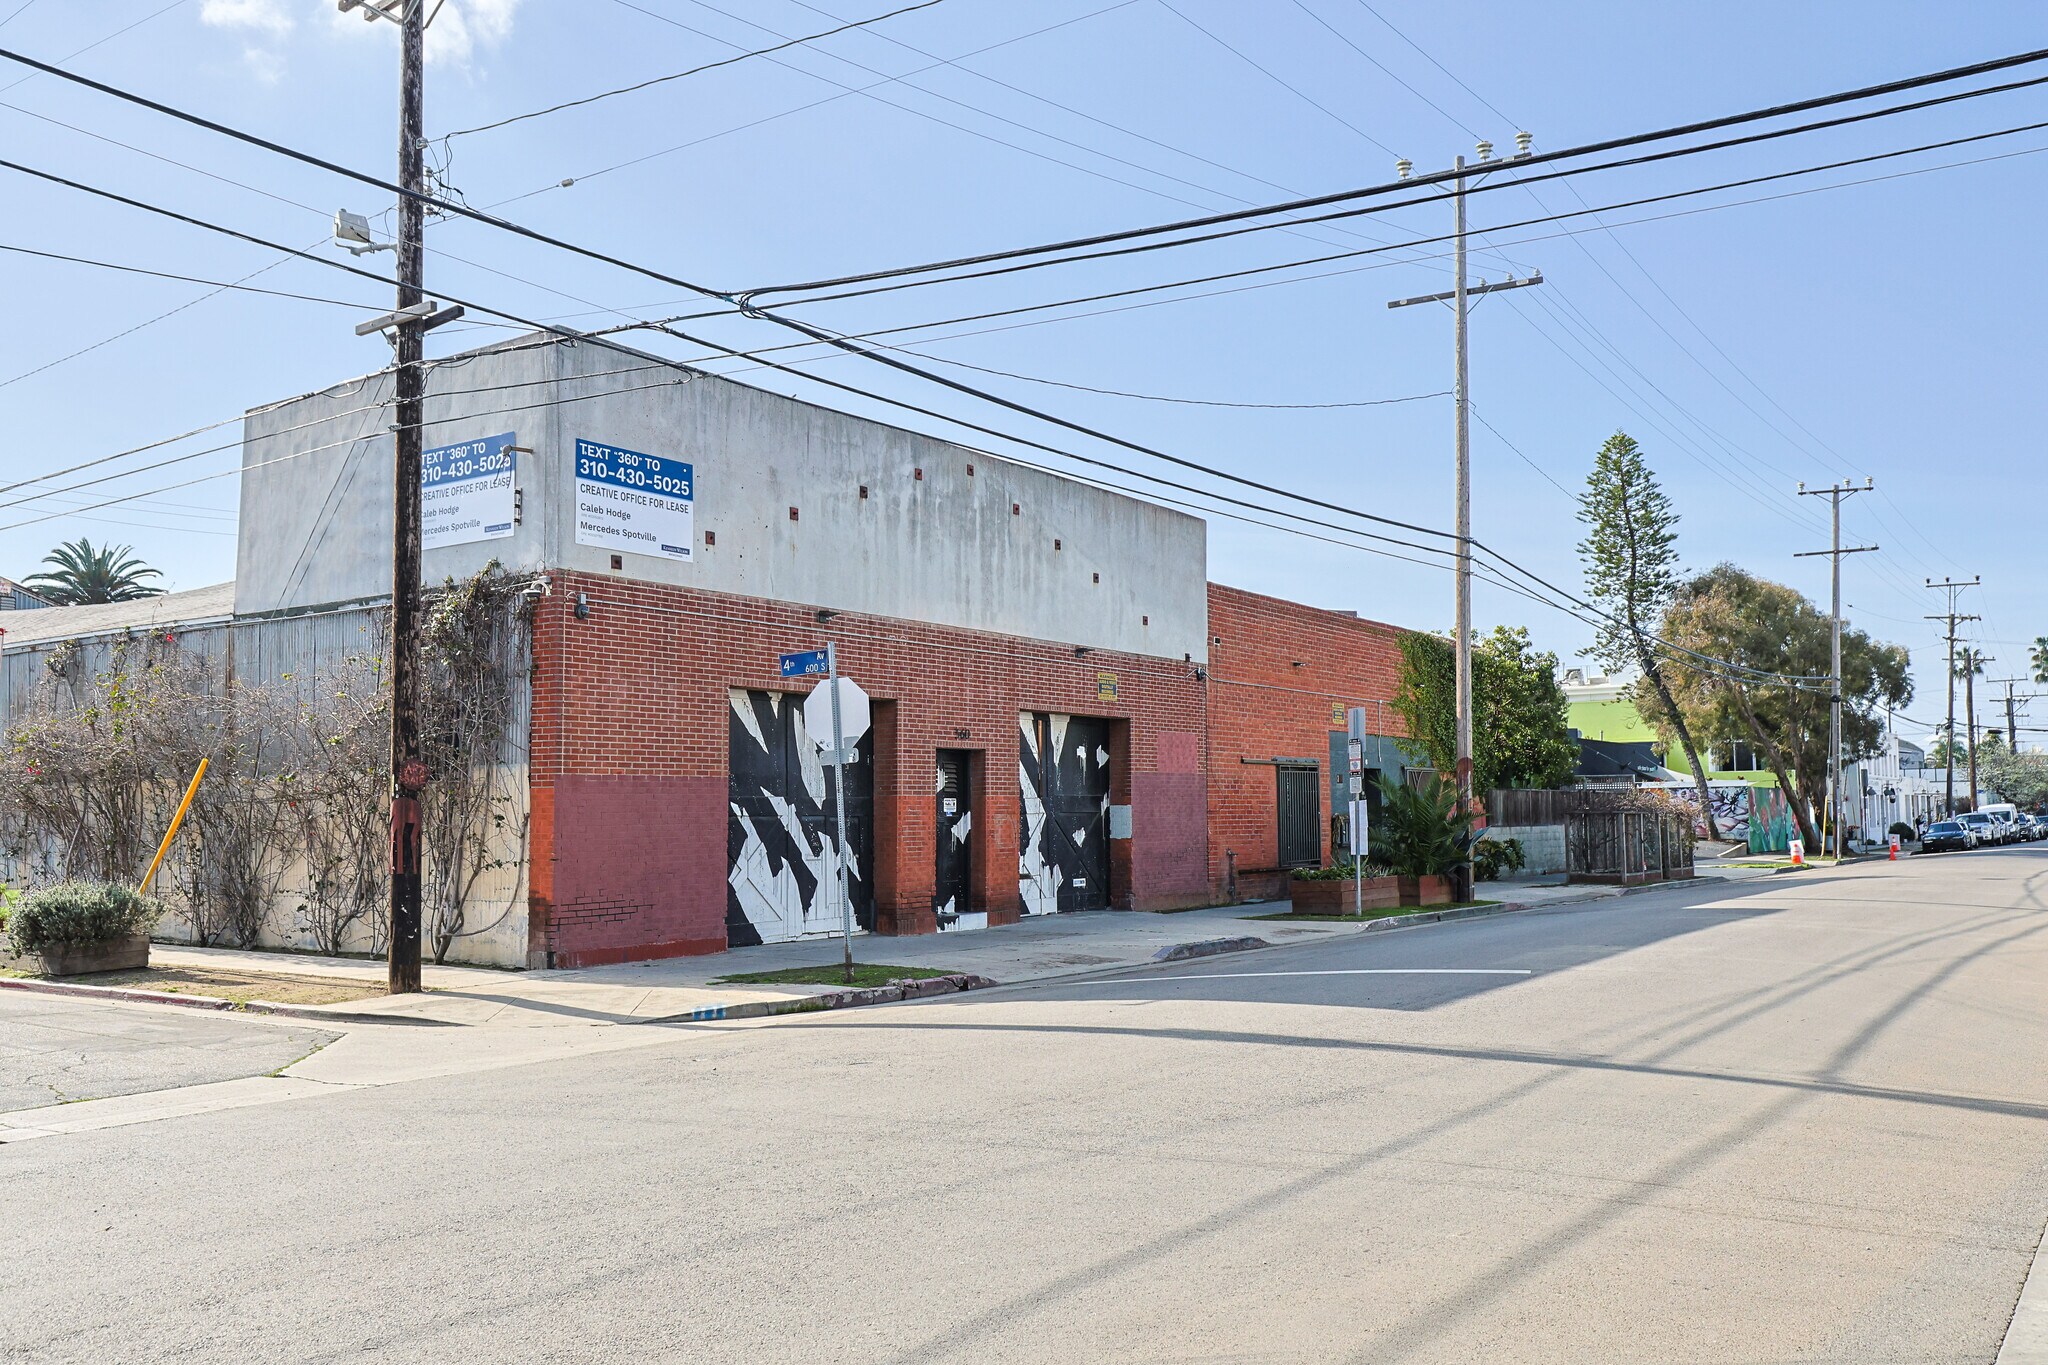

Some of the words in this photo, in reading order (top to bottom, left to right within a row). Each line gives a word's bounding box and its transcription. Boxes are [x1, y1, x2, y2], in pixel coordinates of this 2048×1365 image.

[422, 450, 444, 465] TEXT
[472, 442, 486, 455] TO
[579, 442, 611, 460] TEXT
[645, 458, 661, 472] TO
[580, 458, 689, 496] 310-430-5025
[421, 487, 449, 501] REATIVE
[451, 483, 474, 496] OFFICE
[475, 481, 488, 492] FOR
[490, 476, 511, 489] LEASE
[580, 483, 618, 500] CREATIVE
[620, 491, 647, 506] OFFICE
[649, 498, 664, 509] FOR
[666, 501, 689, 514] LEASE
[422, 508, 437, 518] aleb
[438, 506, 460, 516] Hodge
[580, 503, 604, 514] Caleb
[606, 508, 631, 521] Hodge
[422, 524, 449, 536] ercedes
[451, 519, 480, 532] Spotville
[580, 521, 620, 536] Mercedes
[622, 528, 657, 542] Spotville
[805, 664, 818, 672] 600
[821, 663, 826, 671] S
